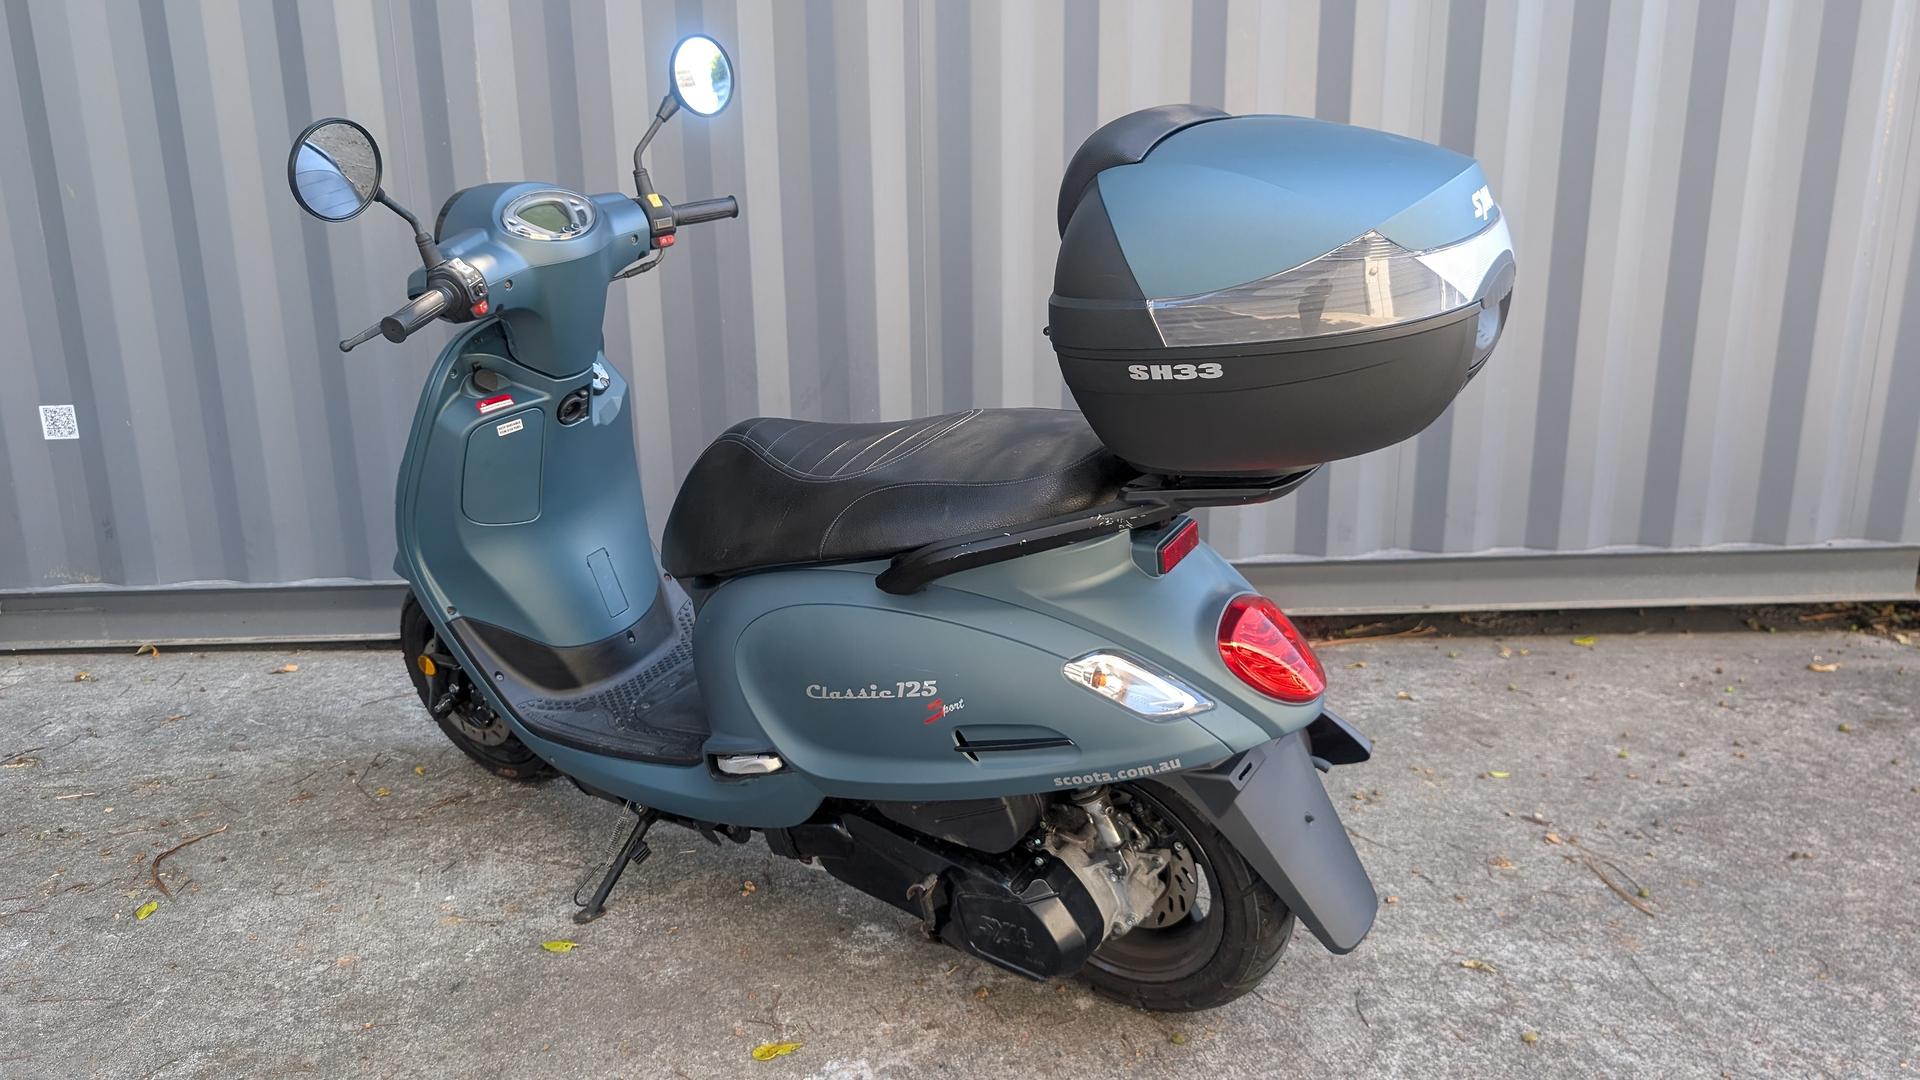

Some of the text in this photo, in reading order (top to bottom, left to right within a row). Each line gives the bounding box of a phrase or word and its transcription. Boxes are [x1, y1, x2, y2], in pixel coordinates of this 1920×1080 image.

[1128, 362, 1224, 381] SH33
[924, 698, 965, 726] Sport
[1053, 758, 1181, 786] scoota.com.au
